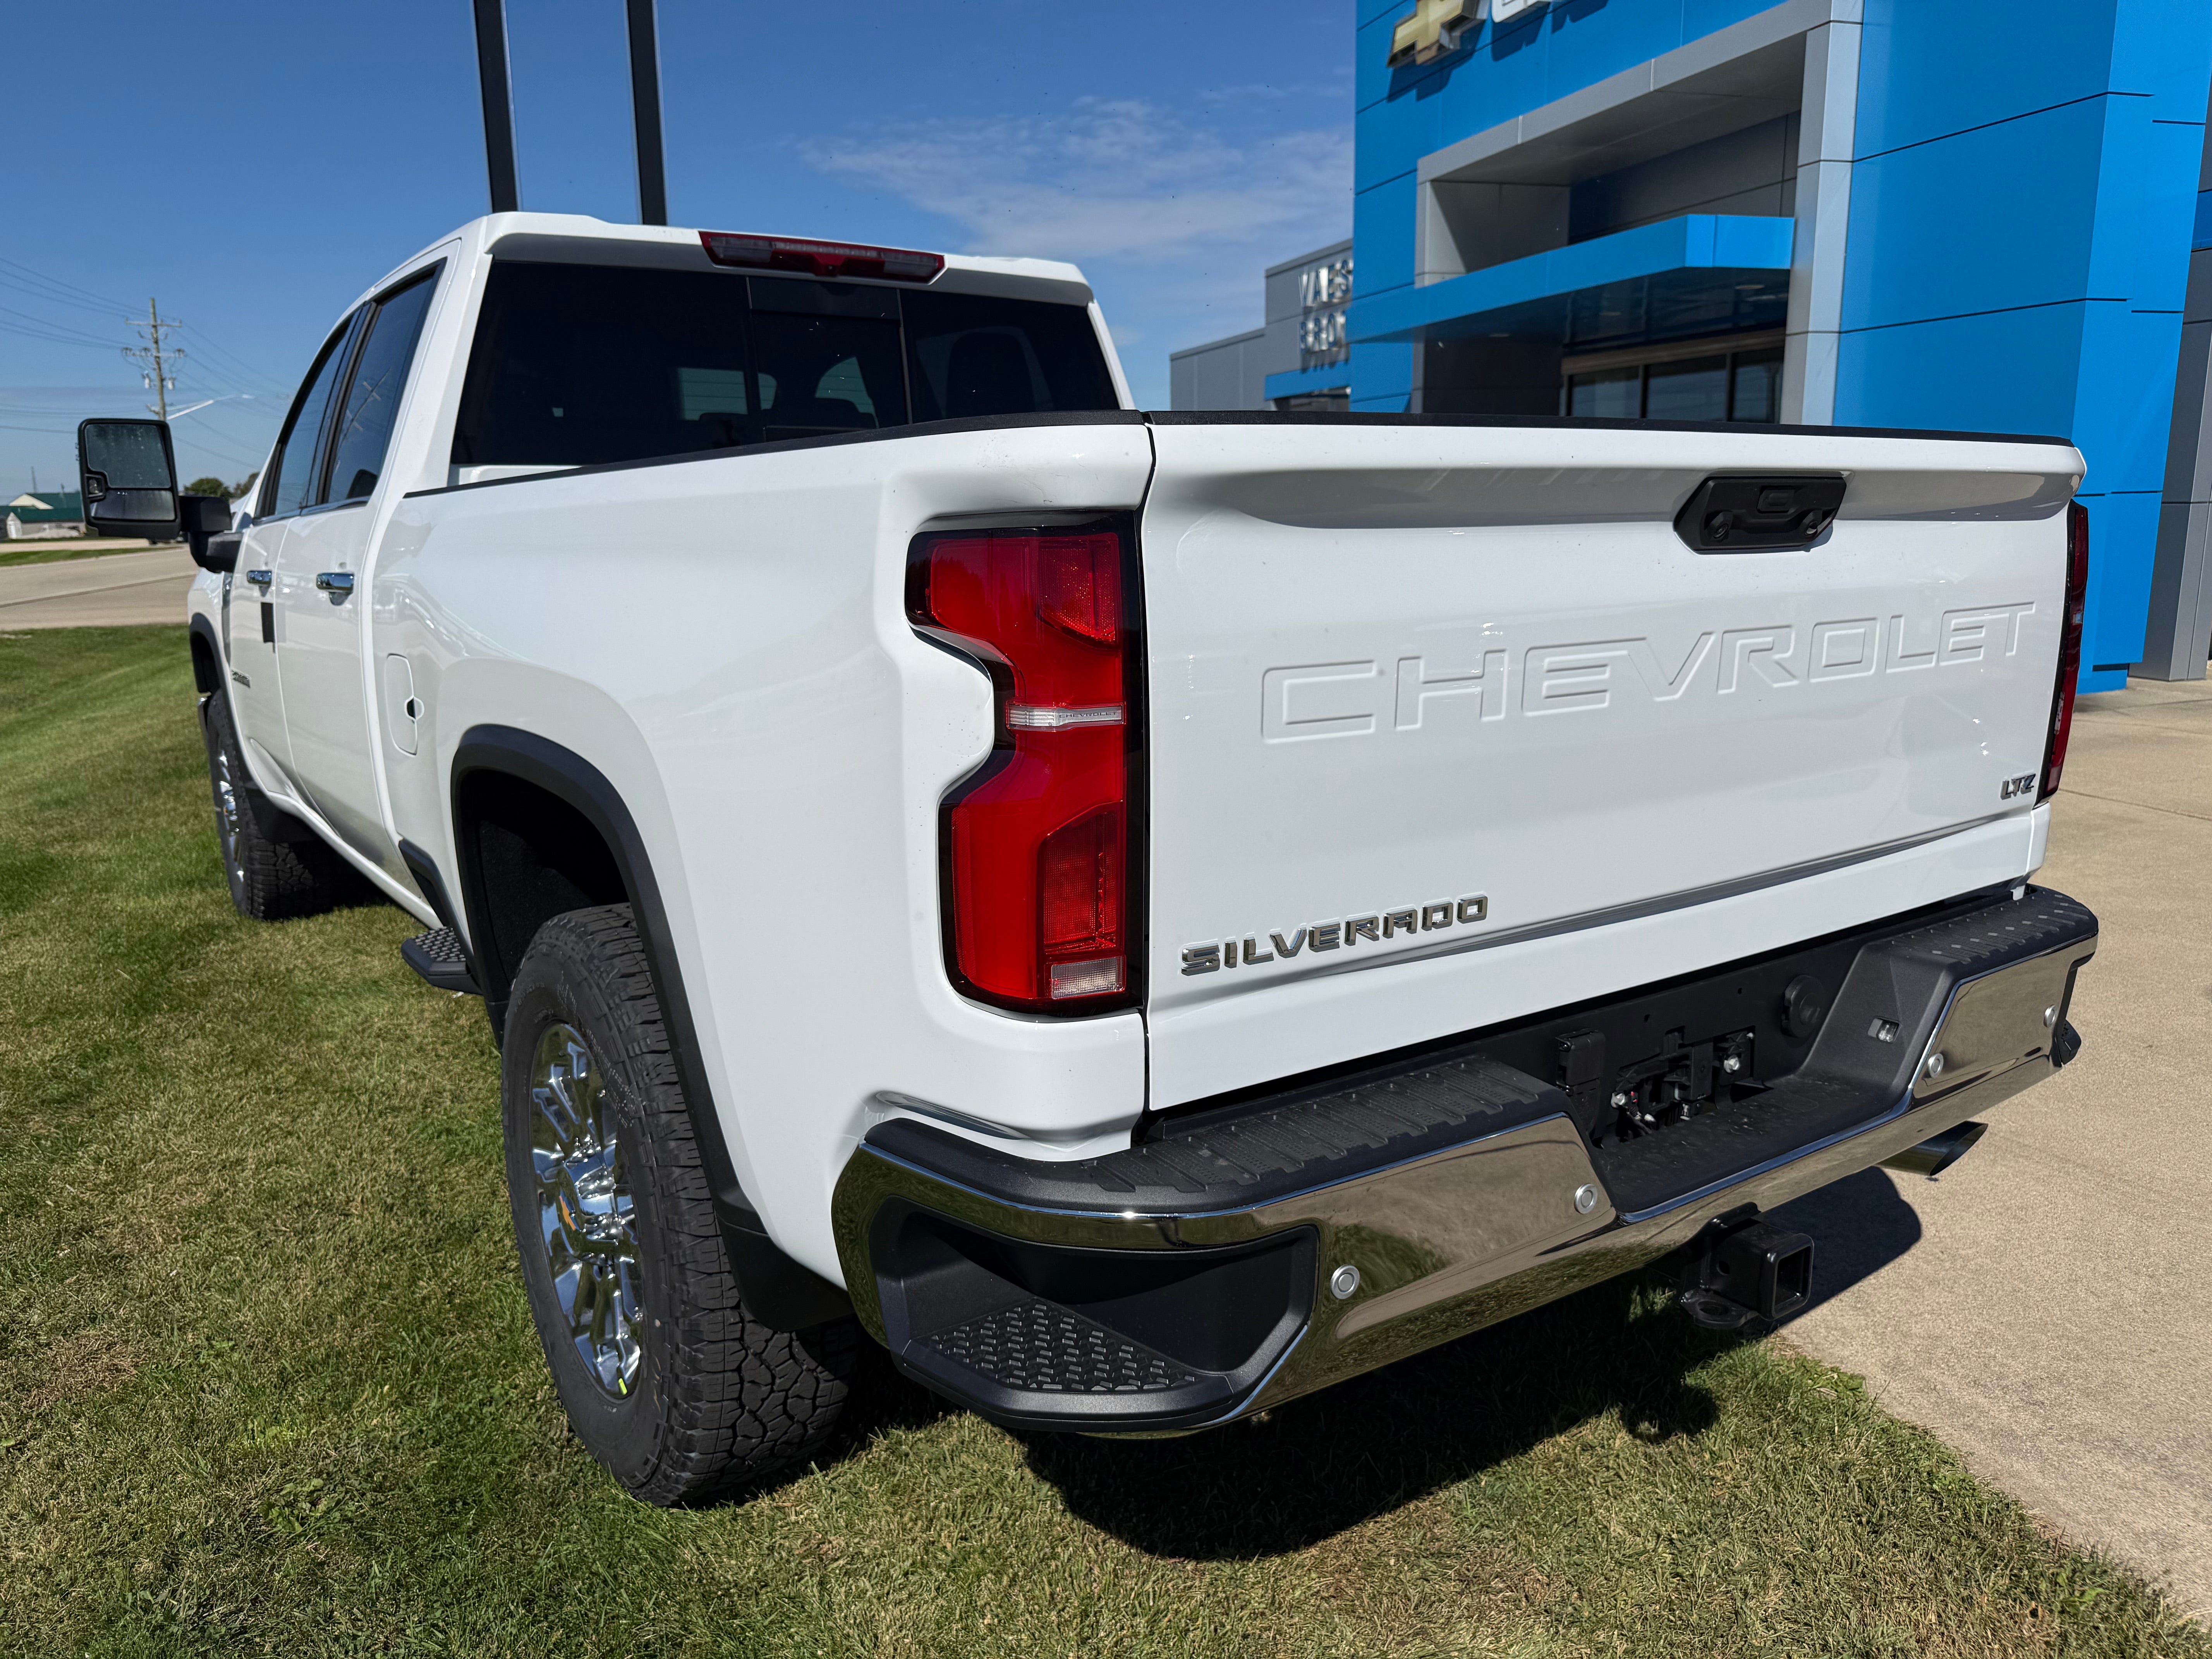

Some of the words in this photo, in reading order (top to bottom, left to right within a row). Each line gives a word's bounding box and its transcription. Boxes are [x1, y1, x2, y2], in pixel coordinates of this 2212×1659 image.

[1261, 601, 2036, 744] CHEVROLET
[2000, 773, 2036, 800] LTZ
[1180, 895, 1488, 976] SILVERADO
